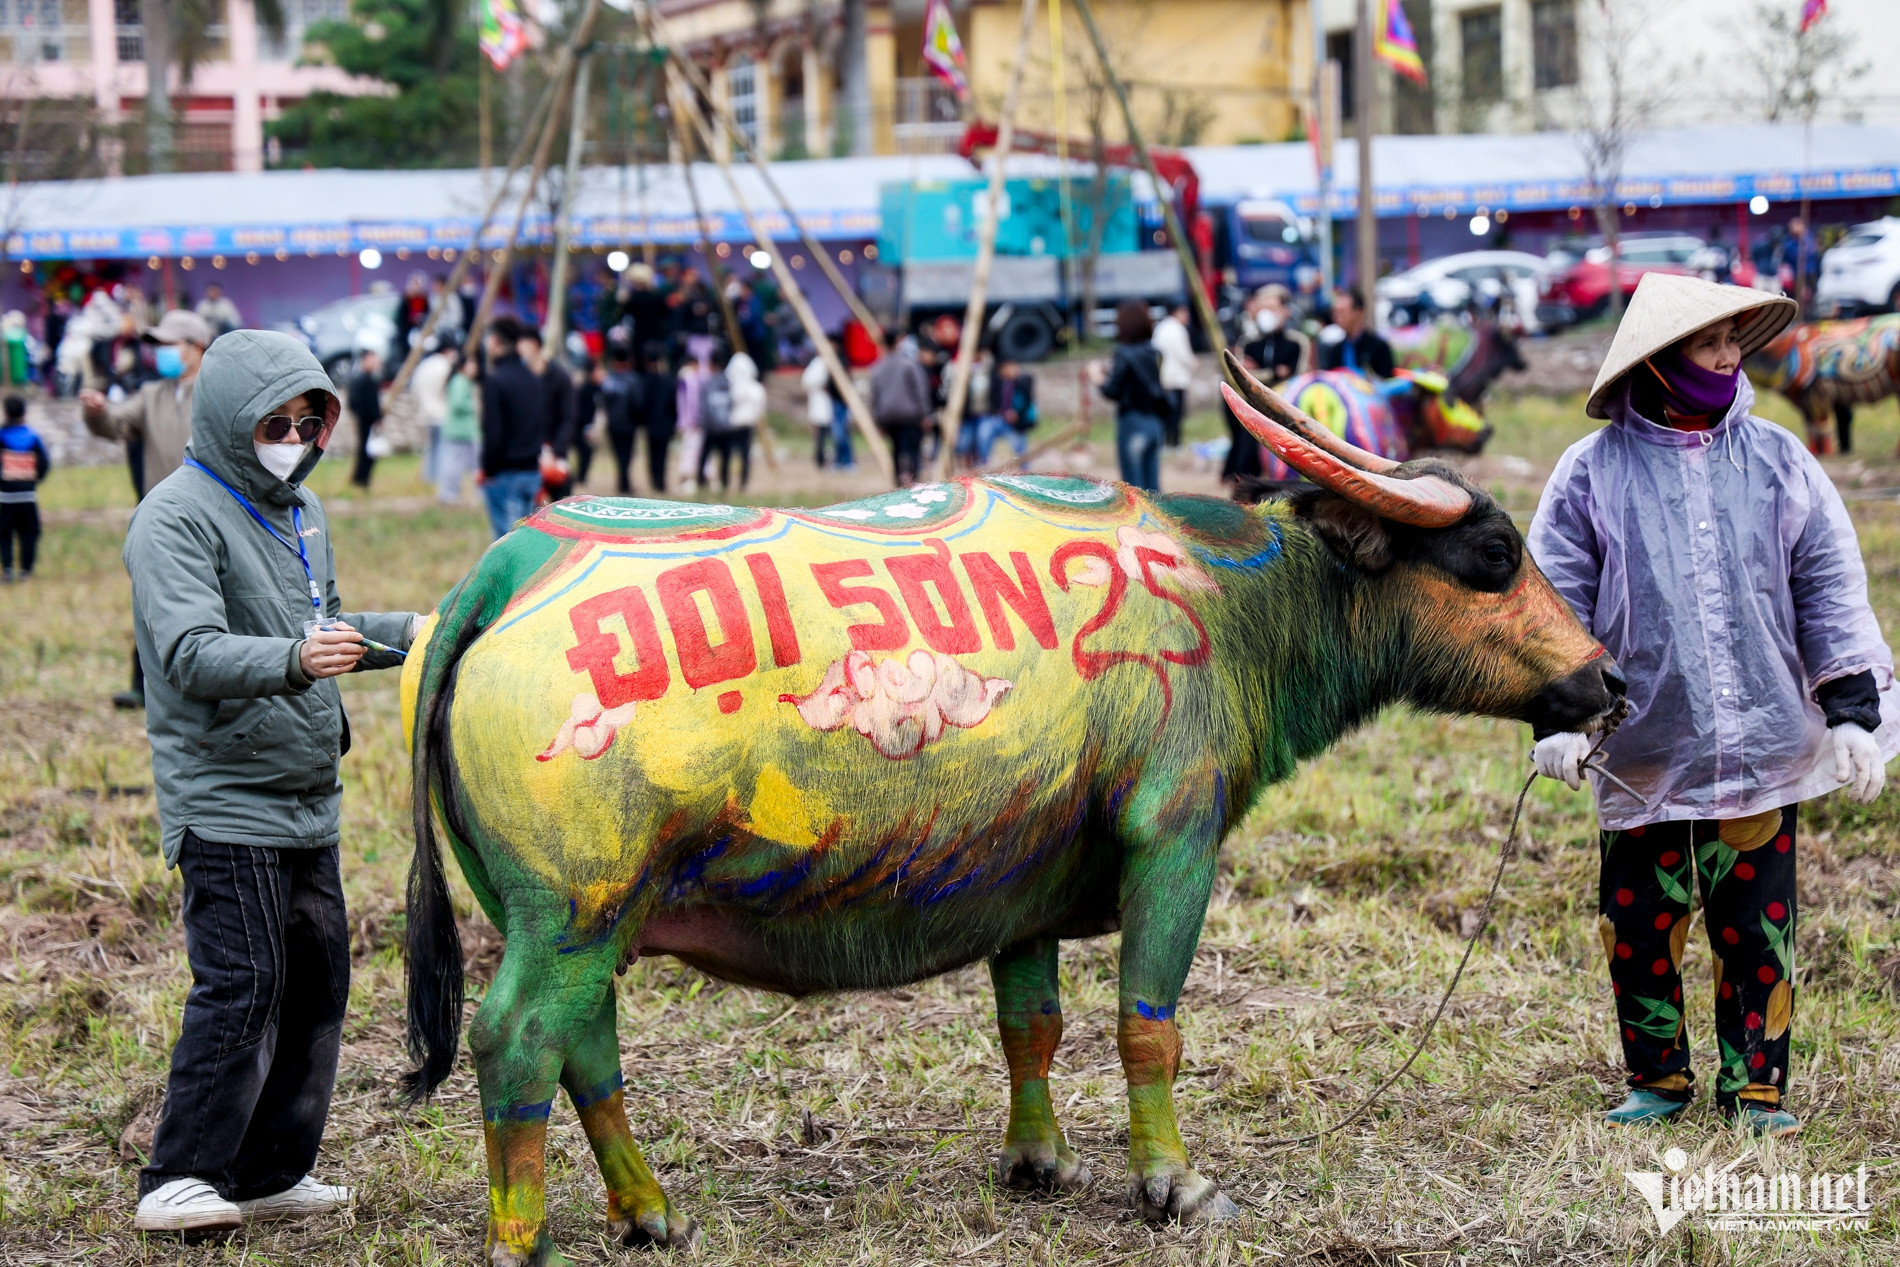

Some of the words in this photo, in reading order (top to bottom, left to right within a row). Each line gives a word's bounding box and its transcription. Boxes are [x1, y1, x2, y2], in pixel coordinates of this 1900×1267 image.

[565, 553, 801, 714] ĐỌI
[809, 538, 1059, 655] SƠN
[1048, 541, 1212, 735] 25
